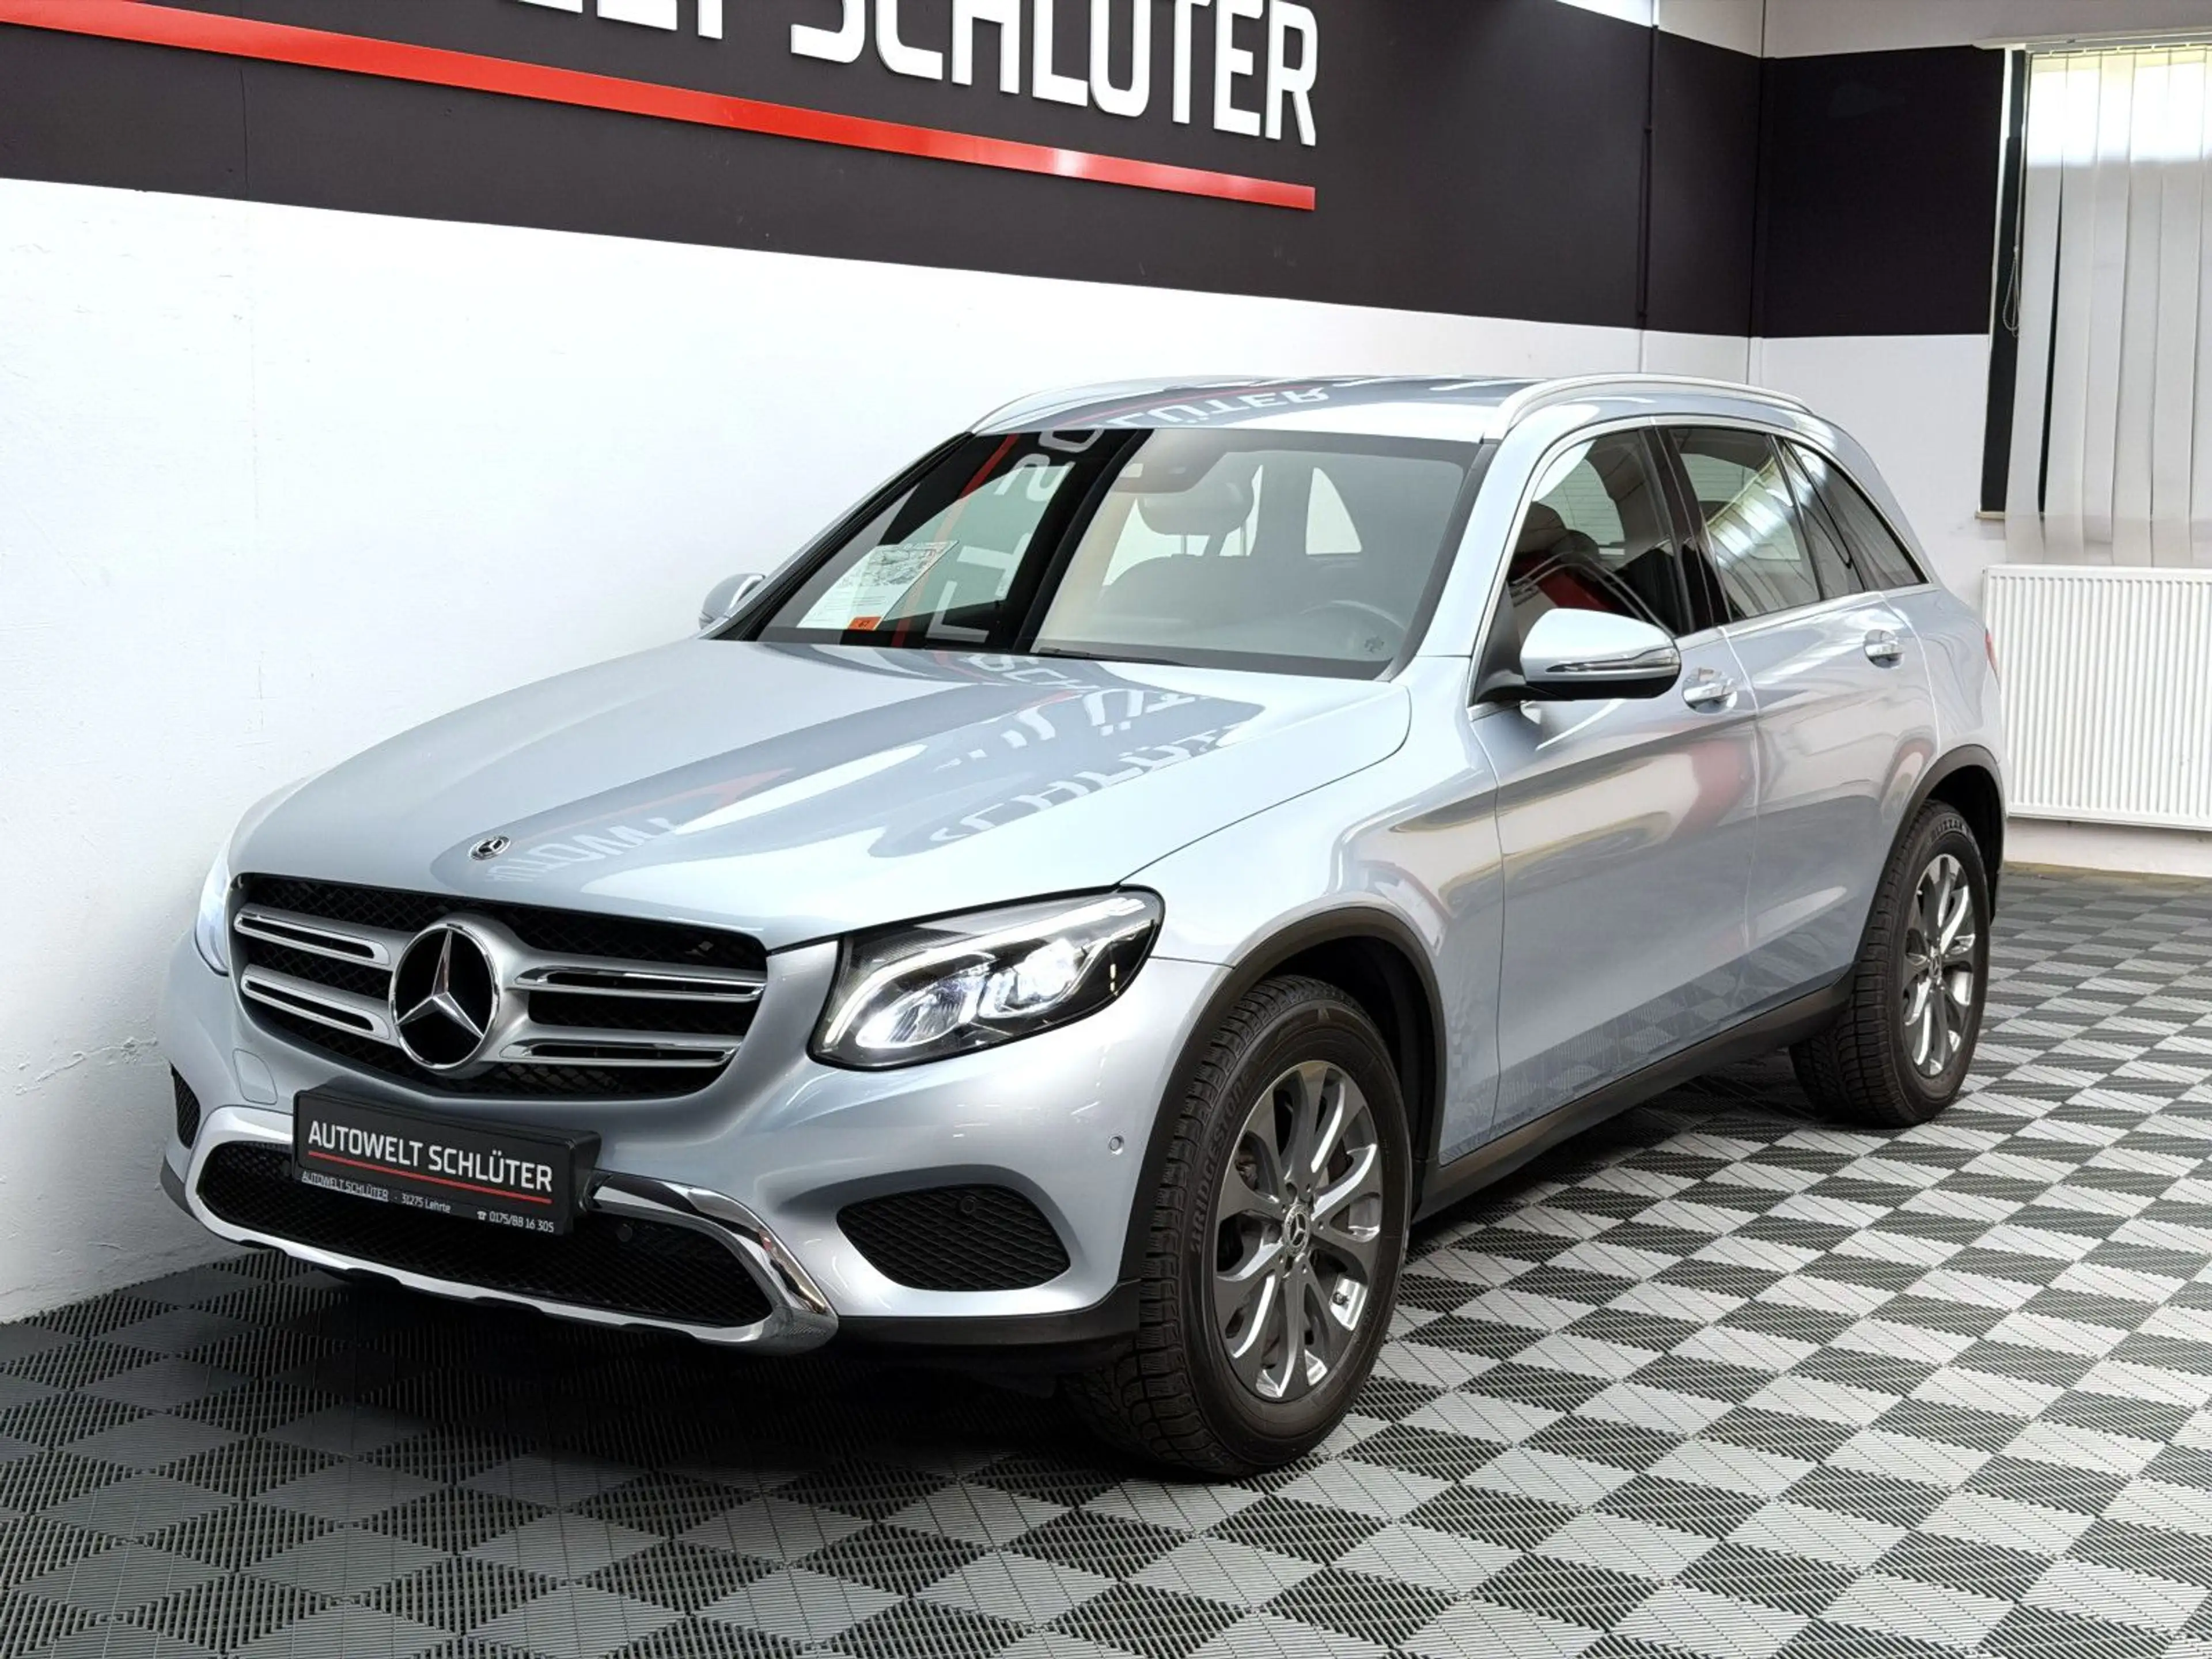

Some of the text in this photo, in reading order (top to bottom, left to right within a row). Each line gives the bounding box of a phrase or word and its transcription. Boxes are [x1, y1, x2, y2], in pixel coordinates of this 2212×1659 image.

[308, 1120, 552, 1192] AUTOWELT SCHLÜTER
[301, 1170, 451, 1213] AUTOWELT SCHLÜTER 31275 Lehrte
[525, 1218, 536, 1230] 16
[537, 1219, 554, 1233] 305
